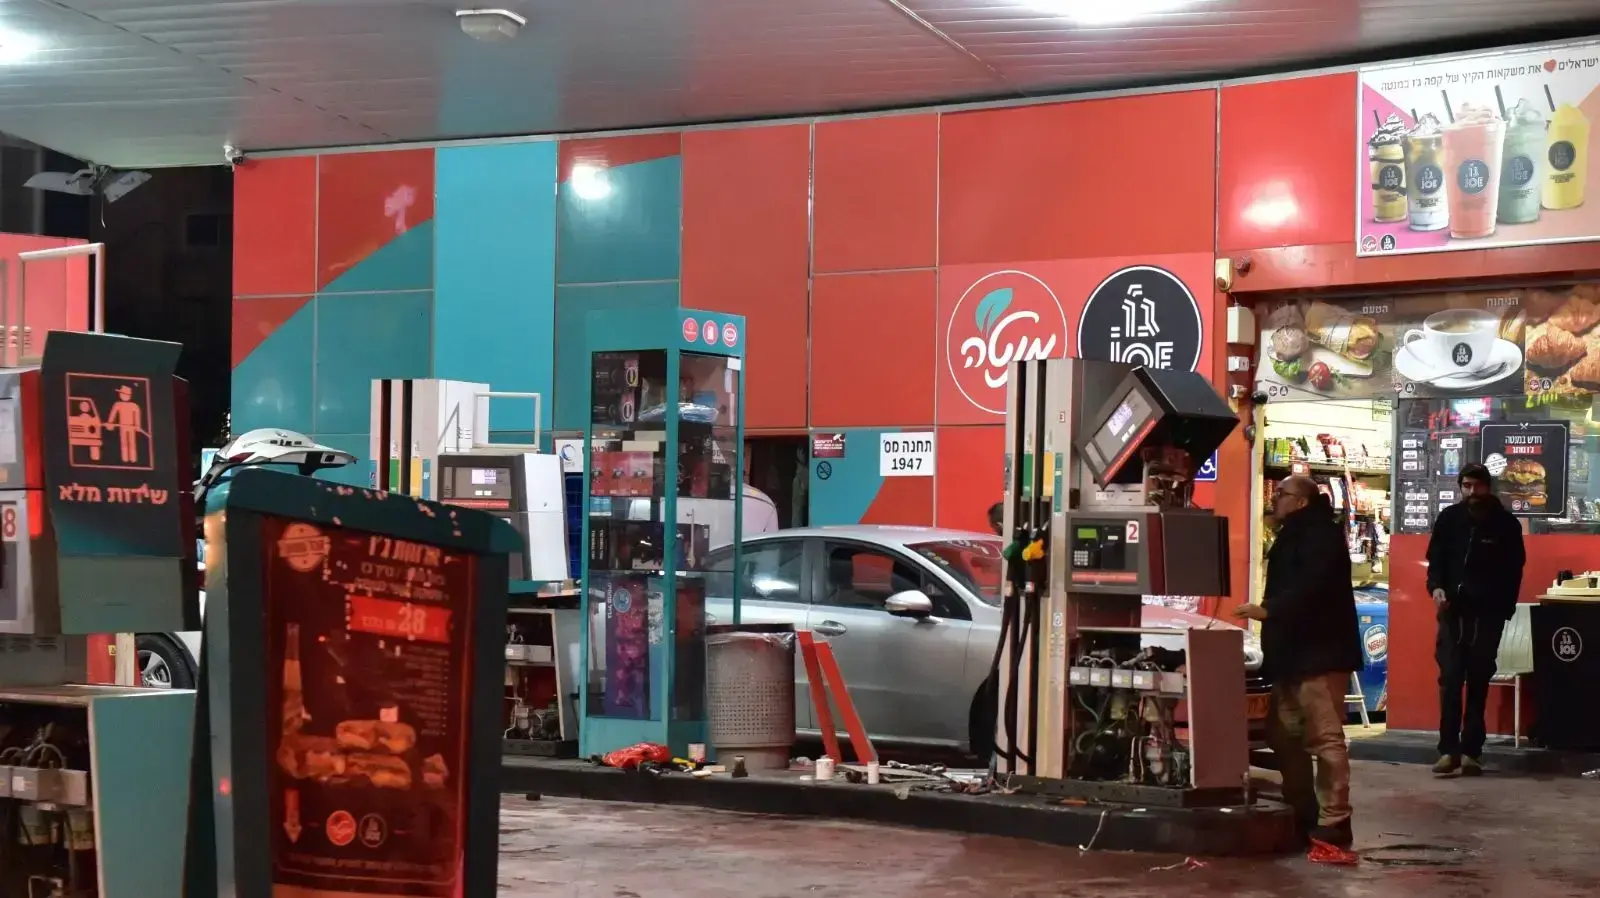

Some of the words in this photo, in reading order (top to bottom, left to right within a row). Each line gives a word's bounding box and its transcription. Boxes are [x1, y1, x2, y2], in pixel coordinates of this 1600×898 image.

[1528, 64, 1541, 74] את
[1558, 57, 1599, 71] ישראלים
[1445, 72, 1459, 83] של
[1462, 71, 1484, 83] הקיץ
[1487, 66, 1525, 80] משקאות
[1381, 81, 1409, 91] במנטה
[1424, 76, 1443, 87] קפה
[1384, 178, 1398, 187] JOE
[1421, 178, 1438, 189] JOE
[1465, 176, 1484, 188] JOE
[1362, 305, 1388, 314] הטעם
[1527, 435, 1543, 444] חדש
[903, 440, 932, 453] תחנה
[891, 457, 923, 471] 1947
[58, 482, 102, 502] מלא
[3, 508, 16, 538] 8
[1128, 523, 1138, 541] 2
[398, 605, 427, 635] 28
[1559, 644, 1577, 655] JOE
